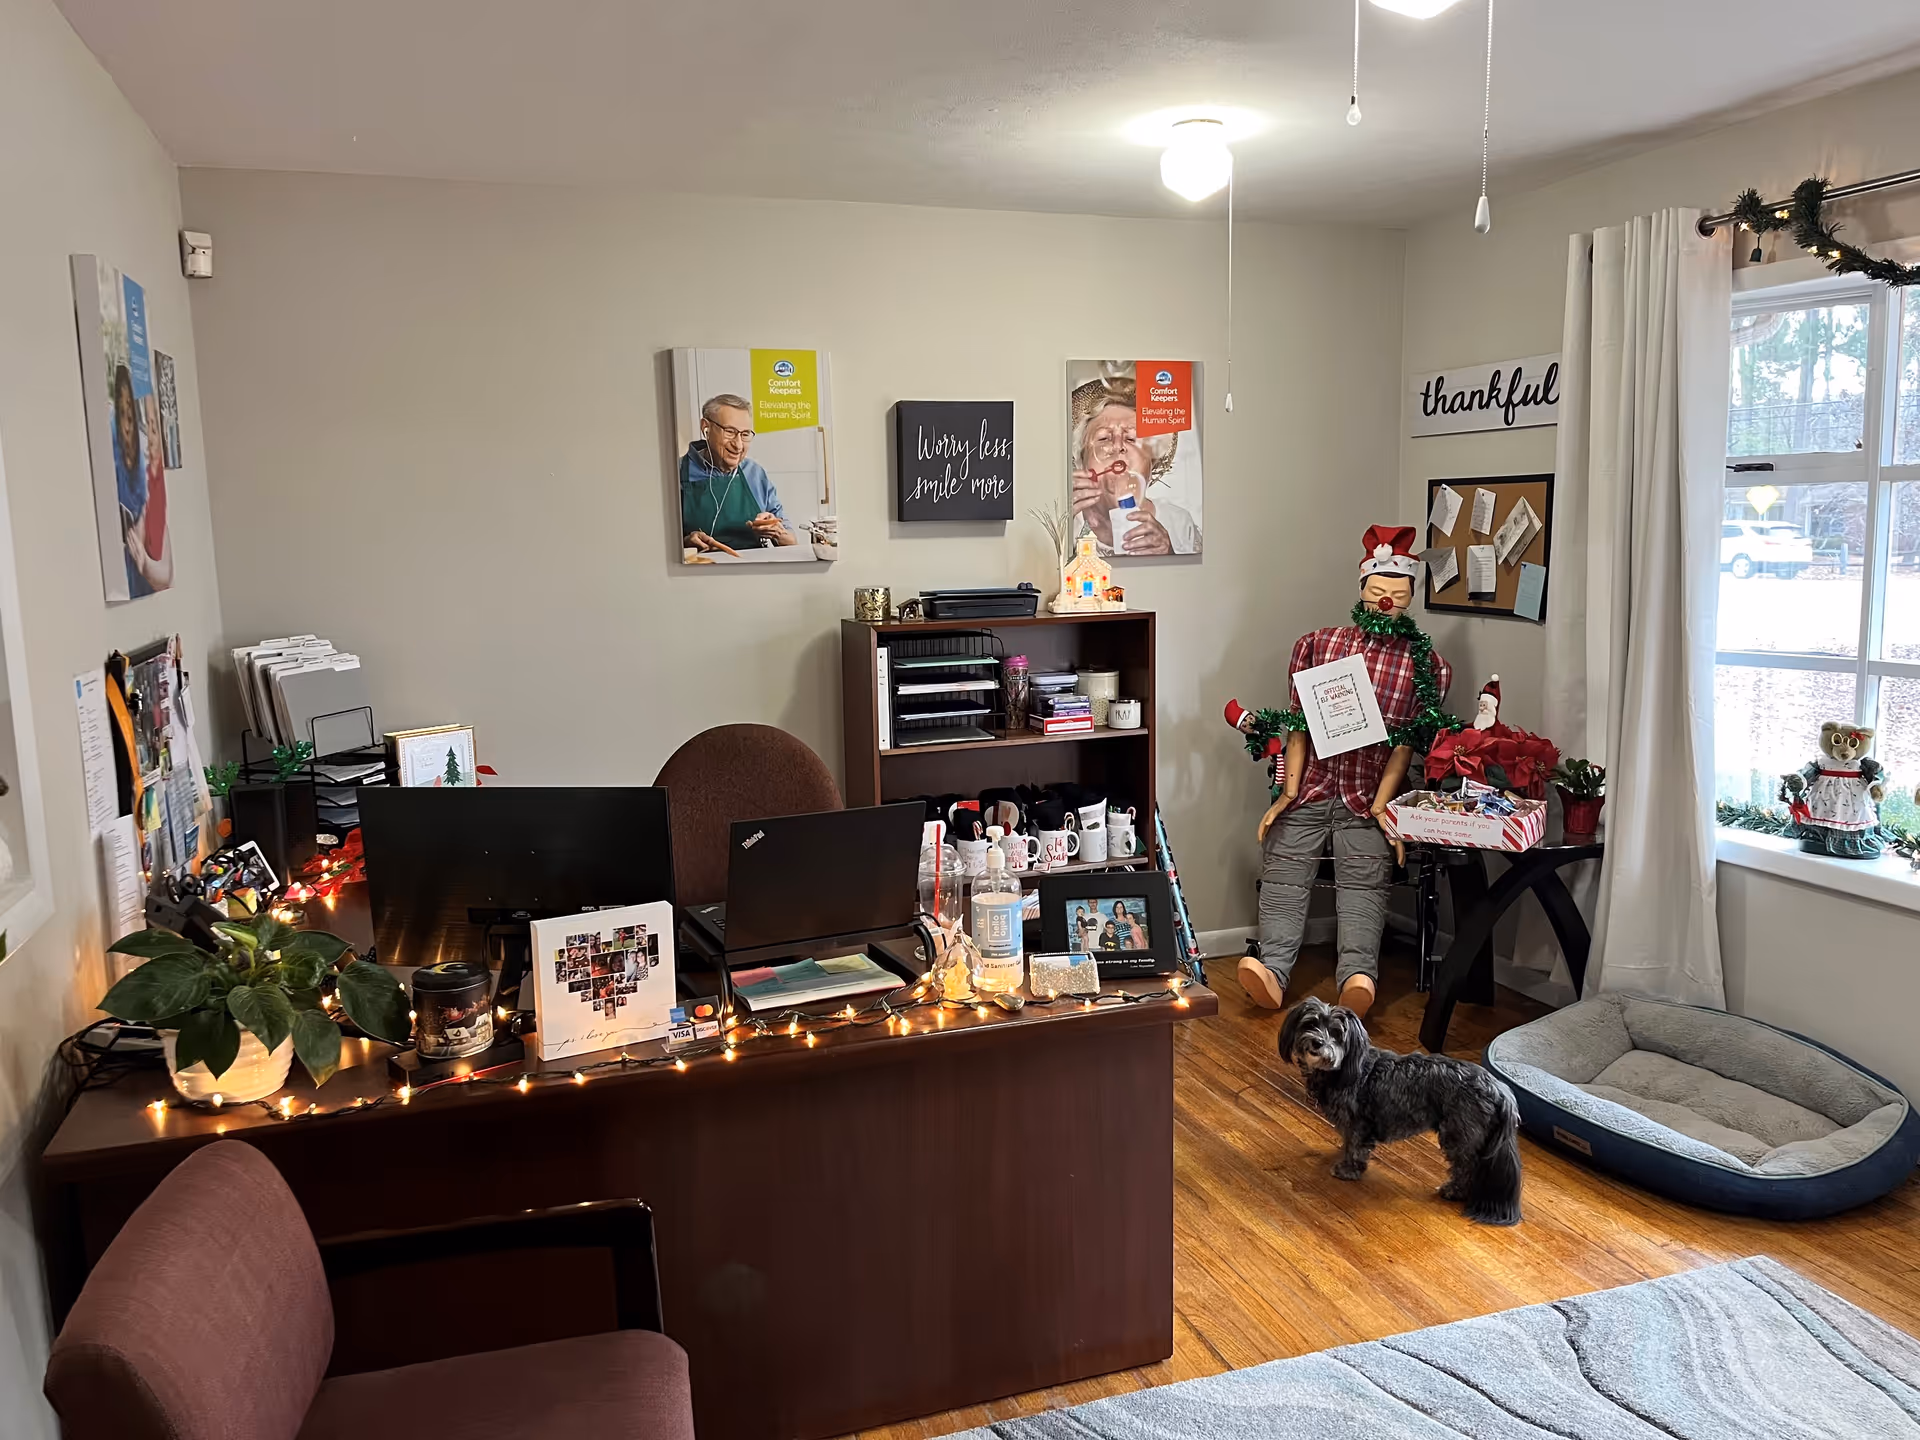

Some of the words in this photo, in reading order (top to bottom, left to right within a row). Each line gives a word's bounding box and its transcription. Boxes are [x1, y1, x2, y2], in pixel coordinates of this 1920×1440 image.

[768, 378, 801, 387] Comfort
[769, 387, 802, 395] Keepers
[1420, 362, 1561, 426] thankful
[759, 400, 797, 410] Elevating
[798, 401, 811, 409] the
[760, 410, 790, 419] Human
[1141, 407, 1173, 416] Elevating
[1142, 416, 1167, 424] Human
[918, 424, 978, 481] Worry
[979, 418, 1013, 461] less,
[904, 463, 963, 503] smile
[971, 474, 1013, 501] more
[1324, 684, 1346, 695] OFFICIAL
[1330, 688, 1353, 700] WARNING
[1409, 813, 1423, 821] Ask
[1424, 816, 1439, 825] your
[1441, 816, 1468, 827] parents
[1469, 819, 1476, 828] if
[1477, 822, 1490, 830] you
[1454, 831, 1473, 839] some
[991, 914, 1000, 937] hello
[1000, 914, 1008, 937] bello
[672, 1030, 691, 1039] VISA
